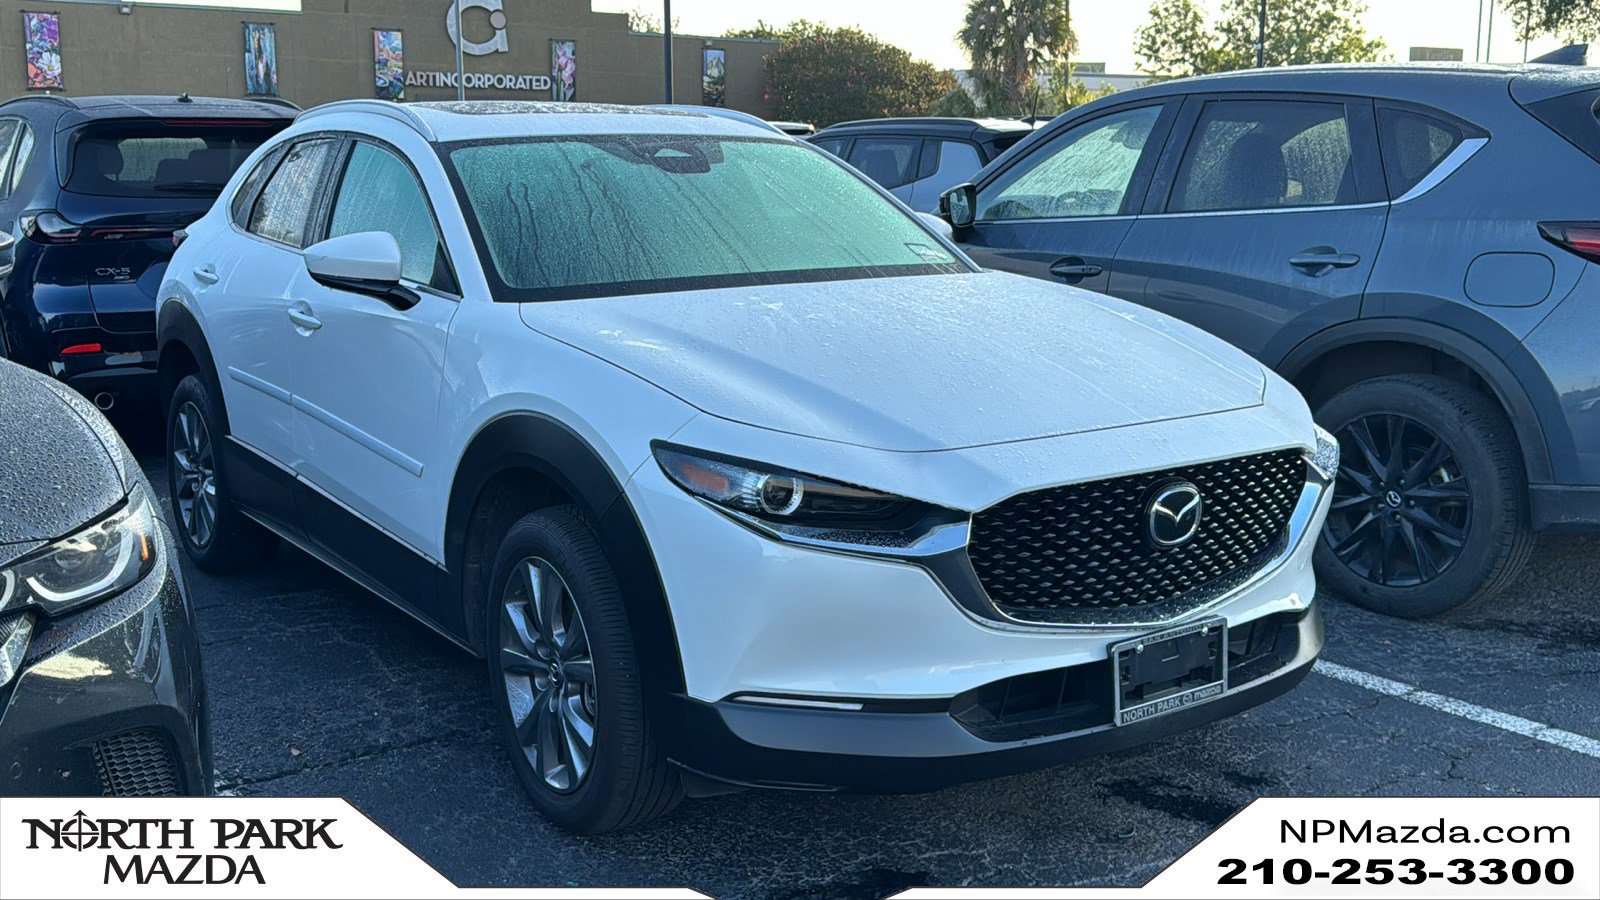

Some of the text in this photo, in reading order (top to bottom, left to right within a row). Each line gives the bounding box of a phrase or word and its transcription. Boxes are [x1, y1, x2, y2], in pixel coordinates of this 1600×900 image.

[95, 267, 131, 276] CX-5
[1123, 704, 1155, 722] NORTH
[1157, 697, 1181, 712] PARK
